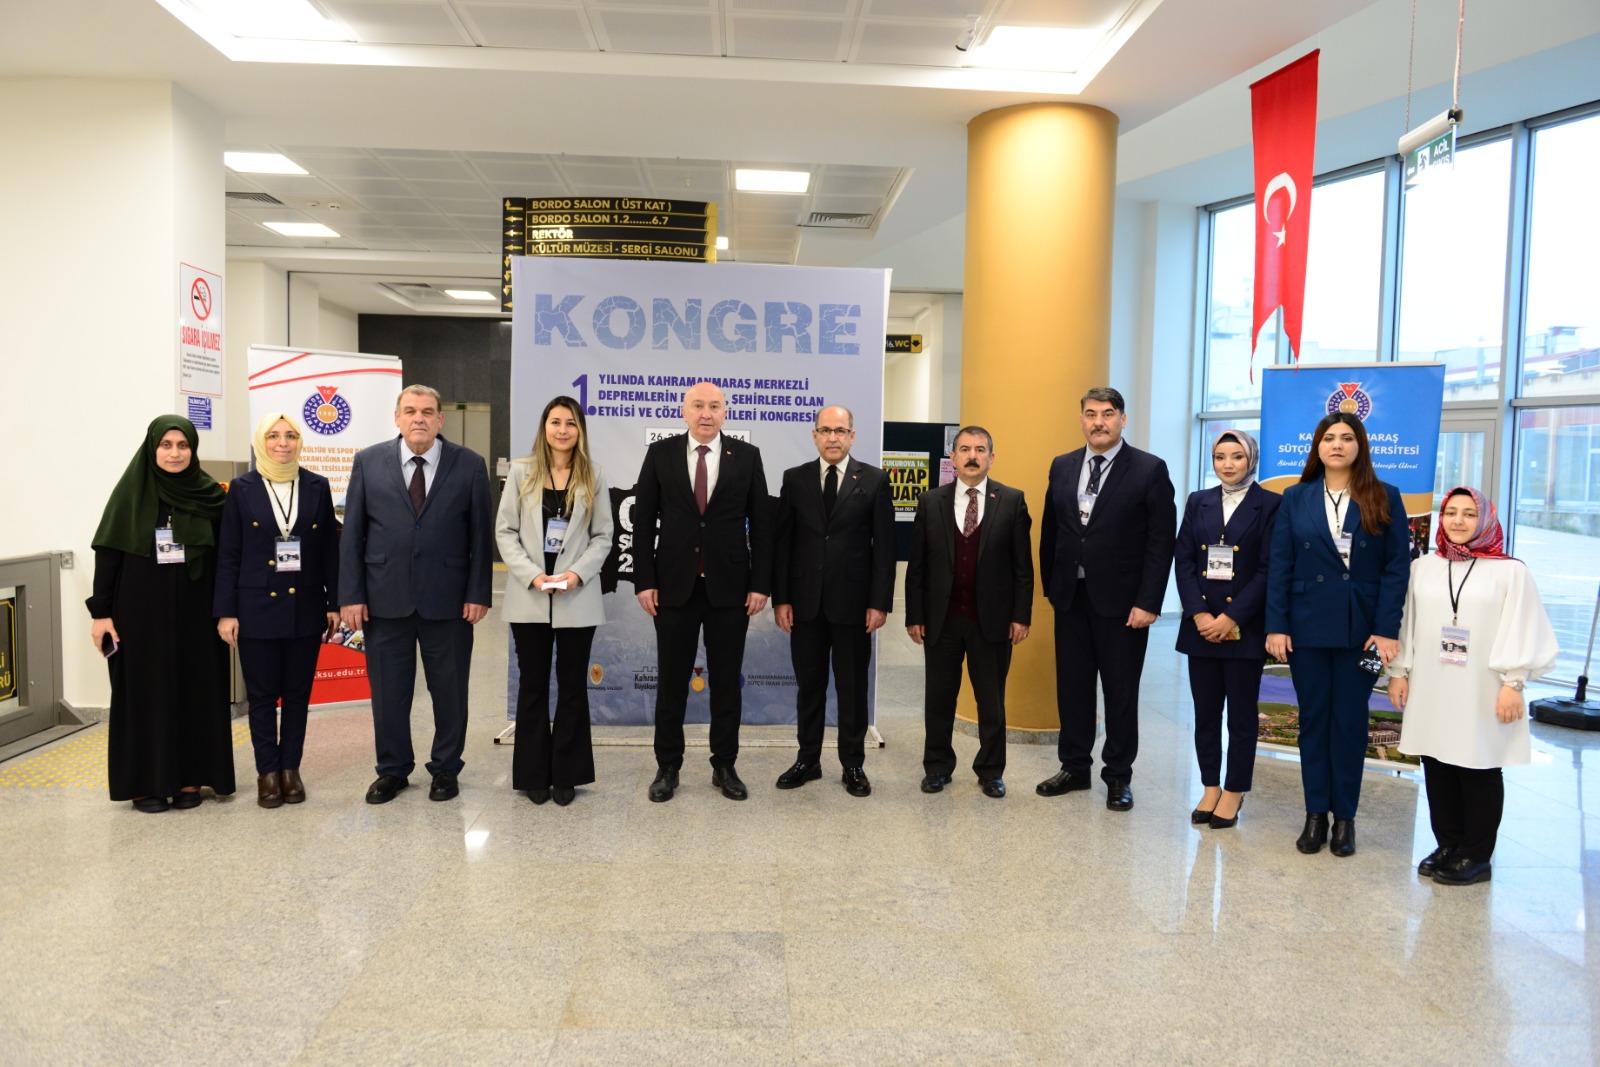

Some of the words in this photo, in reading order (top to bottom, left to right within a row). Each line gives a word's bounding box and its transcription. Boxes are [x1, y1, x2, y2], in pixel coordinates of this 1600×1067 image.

[532, 200, 571, 209] BORDO
[573, 199, 610, 209] SALON
[621, 198, 643, 209] ÜST
[644, 201, 666, 210] KAT
[532, 214, 571, 224] BORDO
[573, 214, 610, 224] SALON
[532, 227, 574, 239] REKTÖR
[531, 242, 571, 254] KÜLTÜR
[573, 241, 613, 253] MÜZESİ
[621, 243, 652, 254] SERGİ
[654, 245, 698, 256] SALONU
[534, 293, 862, 356] KONGRE
[181, 321, 201, 348] SİGARA
[895, 340, 910, 348] WC
[599, 374, 645, 386] YILINDA
[754, 378, 809, 390] MERKEZLİ
[598, 389, 677, 403] DEPREMLERİN
[731, 392, 792, 406] ŞEHİRLERE
[794, 396, 824, 407] OLAN
[598, 404, 635, 418] ETKİSİ
[638, 408, 652, 418] VE
[760, 409, 817, 423] KONGRESİ
